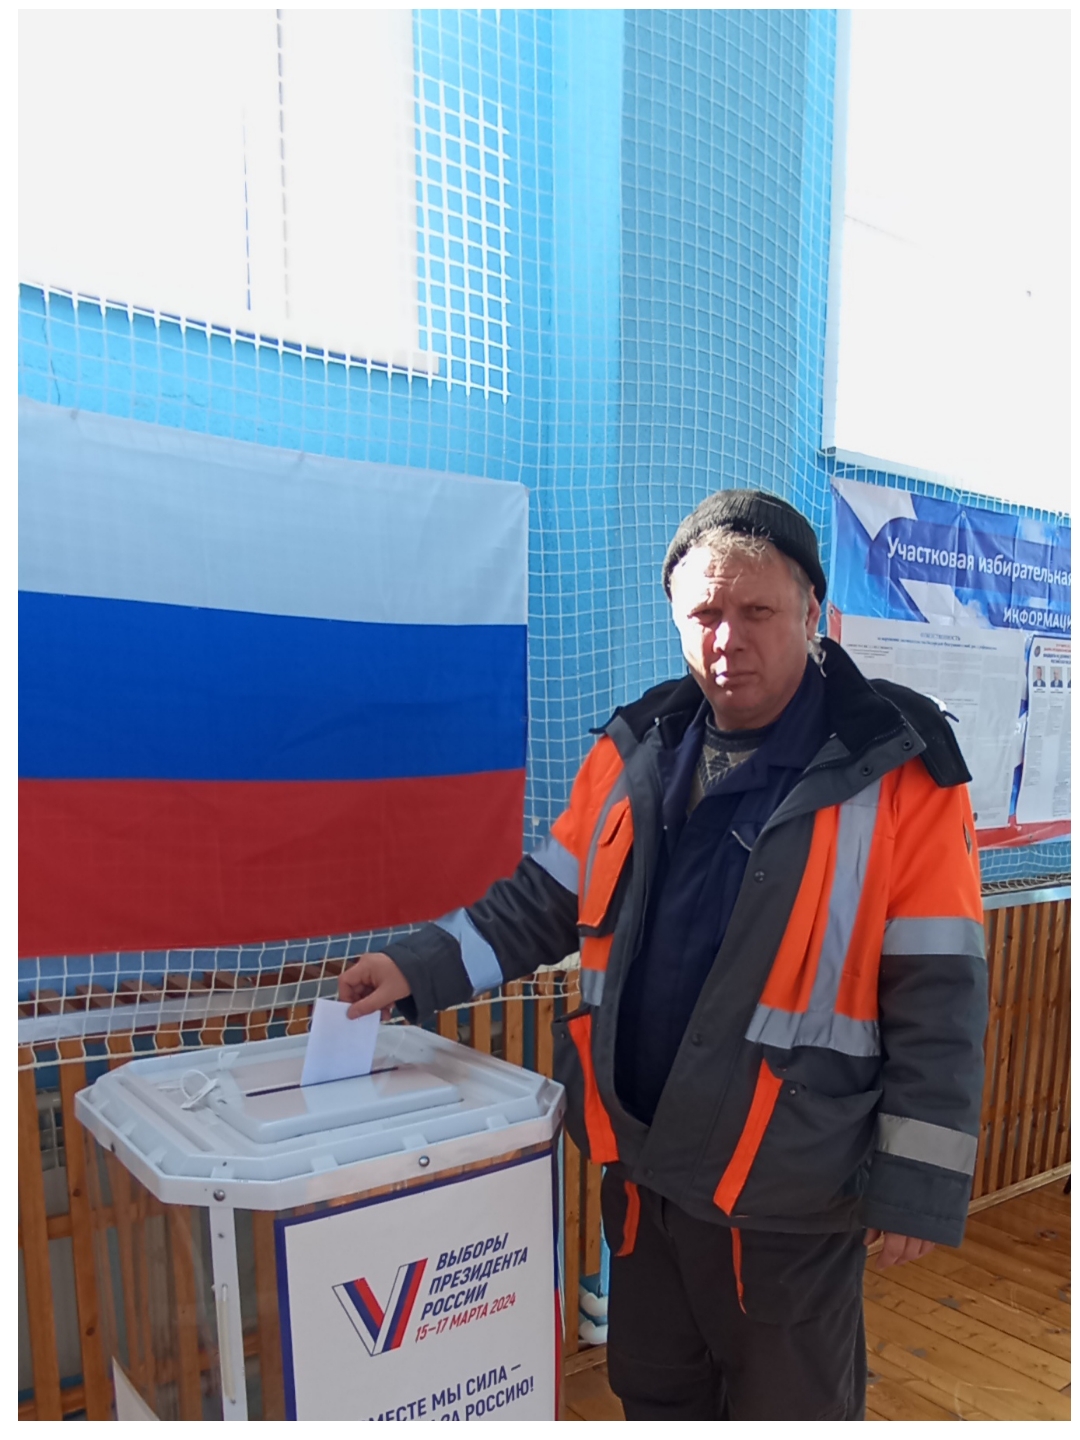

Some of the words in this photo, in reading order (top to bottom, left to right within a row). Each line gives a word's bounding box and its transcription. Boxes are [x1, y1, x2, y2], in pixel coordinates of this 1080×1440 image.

[888, 536, 974, 570] Участковая
[428, 1247, 528, 1295] ПРЕЗИДЕНТА
[436, 1232, 509, 1271] ВЫБОРЫ
[420, 1282, 488, 1321] РОССИИ
[449, 1303, 488, 1330] МАРТА
[489, 1292, 516, 1315] 2024
[432, 1383, 461, 1411] МЫ
[466, 1365, 507, 1396] СИЛА
[465, 1375, 534, 1421] РОССИЮ!
